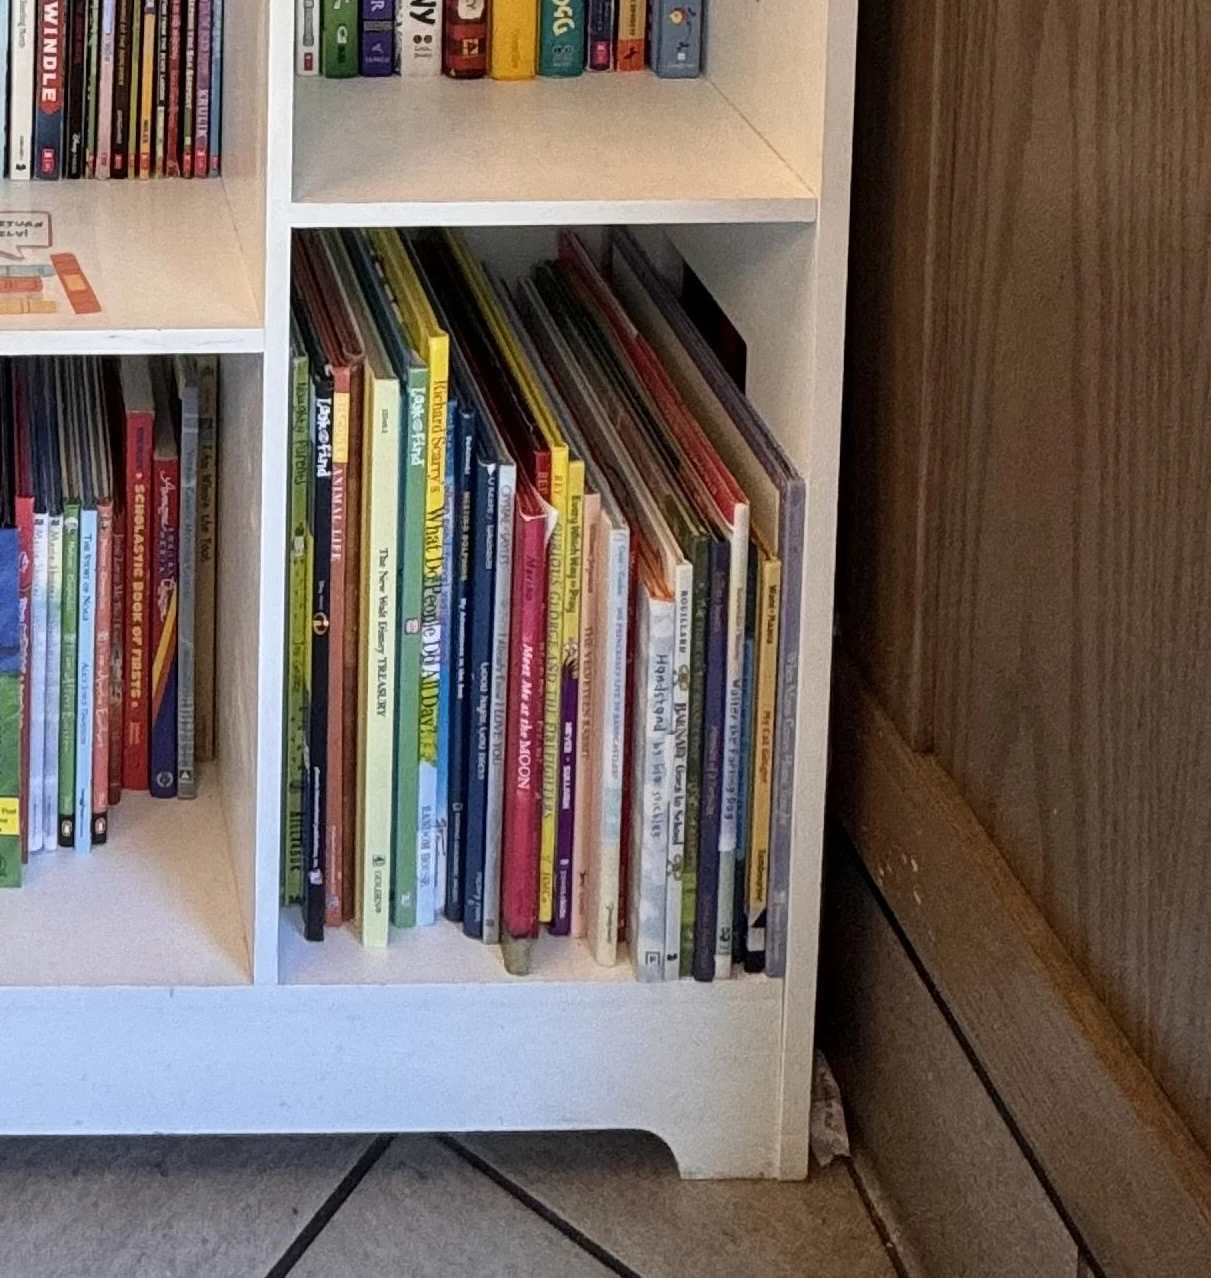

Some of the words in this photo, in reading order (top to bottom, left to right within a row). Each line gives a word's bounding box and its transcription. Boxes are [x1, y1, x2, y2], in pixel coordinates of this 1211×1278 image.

[430, 380, 448, 434] Richard
[429, 436, 447, 493] Scarry's
[331, 468, 344, 523] ANIMAL
[133, 484, 146, 577] SCHOLASTIC
[331, 528, 343, 563] LIFE
[426, 506, 445, 554] What
[379, 548, 389, 568] The
[133, 581, 144, 626] BOOK
[379, 570, 389, 593] New
[378, 596, 389, 619] Walt
[420, 585, 443, 637] People
[131, 626, 142, 645] OF
[374, 621, 388, 654] Disney
[130, 648, 142, 698] FIRSTS
[376, 657, 388, 717] TREASURY
[420, 669, 443, 691] All
[651, 653, 669, 732] Handstand
[420, 694, 441, 737] Day?
[517, 740, 531, 790] MOON
[670, 810, 684, 846] School
